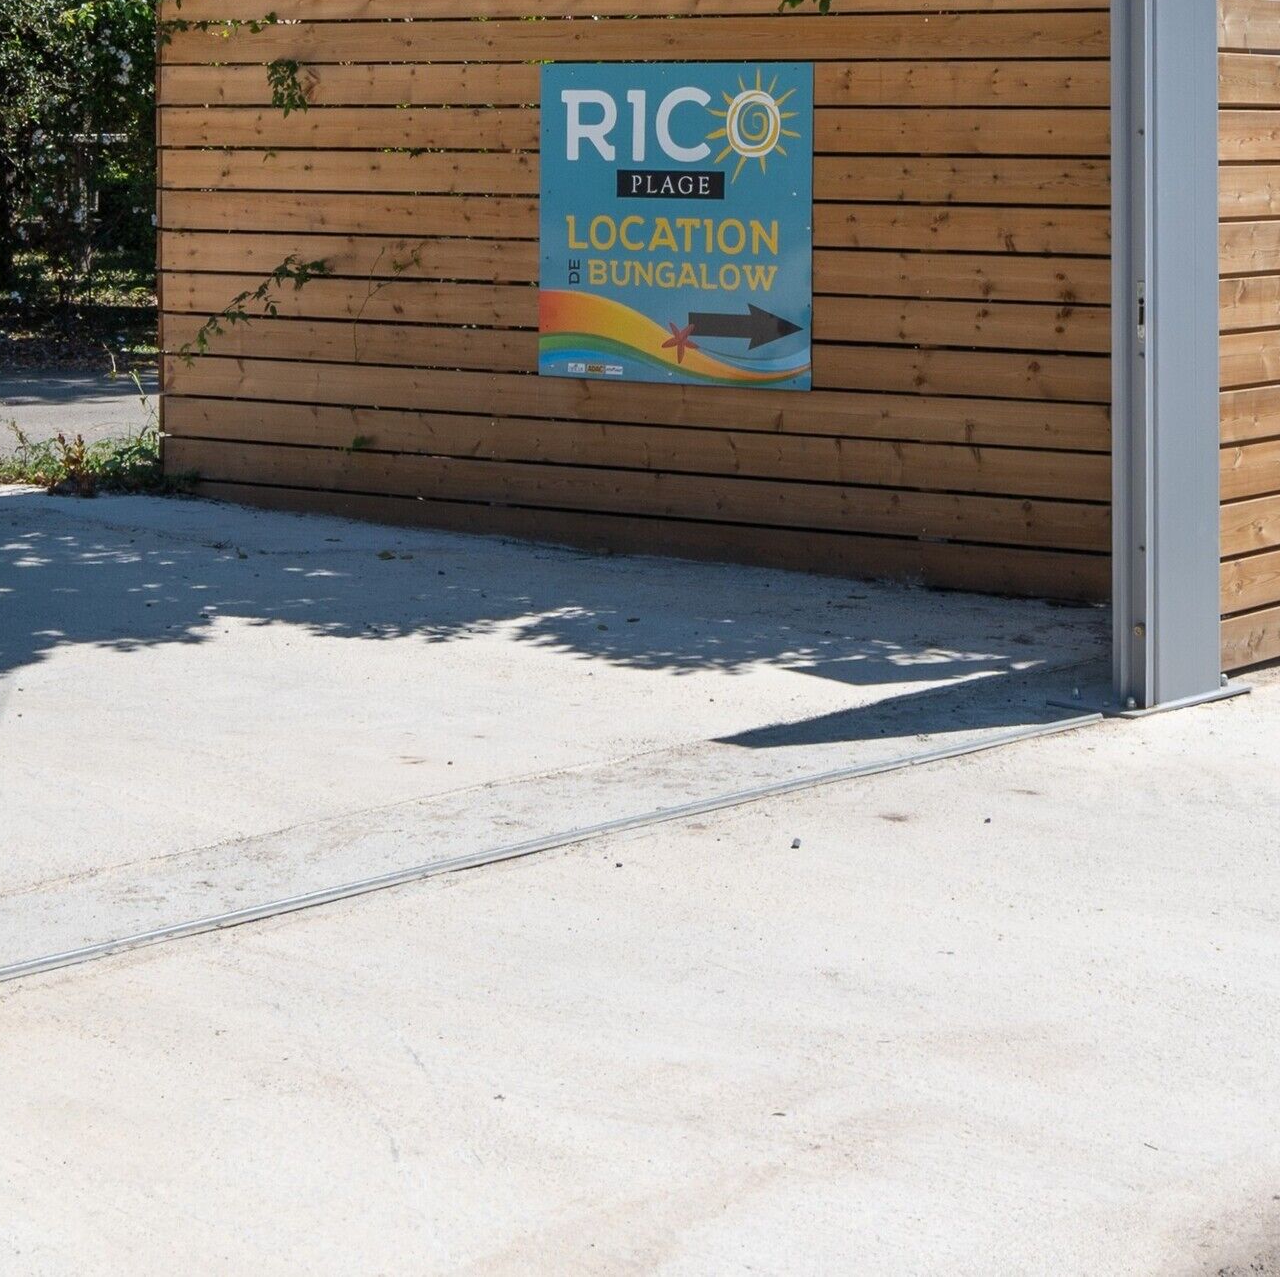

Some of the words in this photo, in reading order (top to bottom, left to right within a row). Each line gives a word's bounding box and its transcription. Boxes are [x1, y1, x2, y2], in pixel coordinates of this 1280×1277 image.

[561, 87, 781, 162] RICO
[631, 175, 711, 195] PLAGE
[566, 215, 779, 255] LOCATION
[569, 259, 580, 284] DE
[588, 259, 778, 291] BUNGALOW
